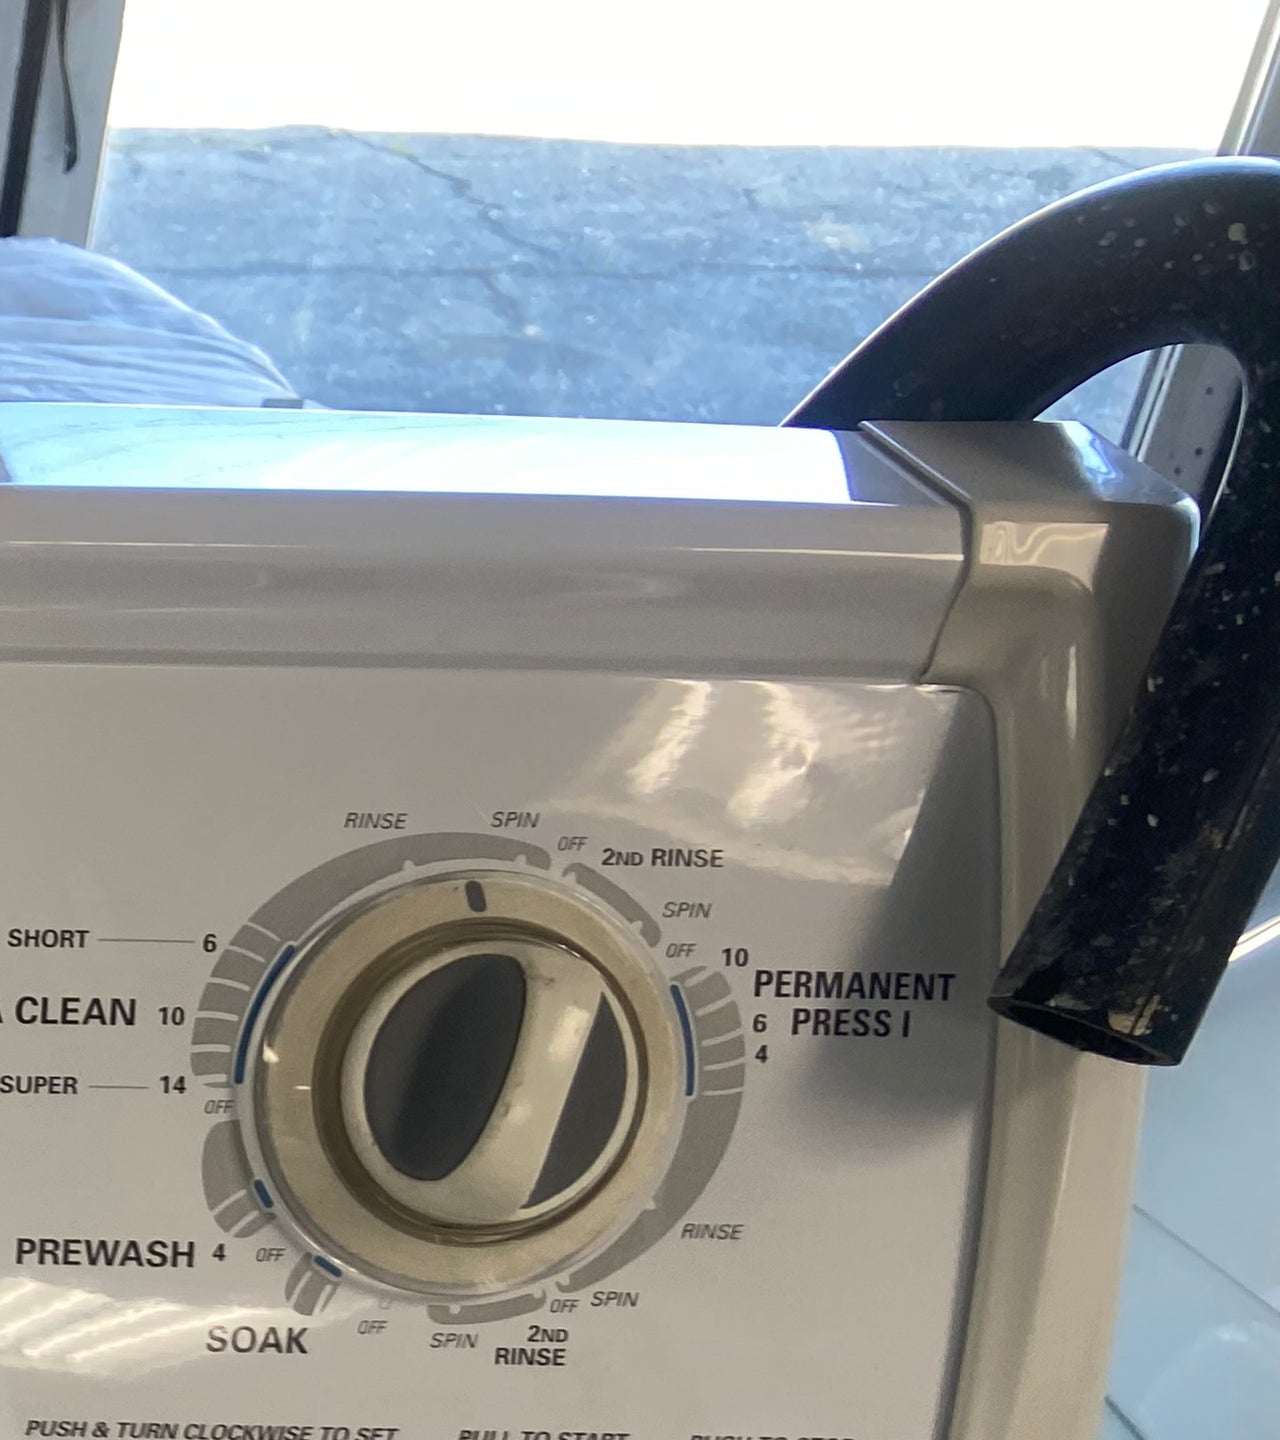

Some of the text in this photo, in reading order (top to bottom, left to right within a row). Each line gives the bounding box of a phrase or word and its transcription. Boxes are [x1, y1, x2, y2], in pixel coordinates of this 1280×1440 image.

[344, 812, 408, 830] RINSE
[491, 811, 540, 829] SPIN
[557, 836, 588, 853] OFF
[601, 847, 725, 869] 2ND RINSE
[662, 901, 713, 919] SPIN
[7, 929, 90, 948] SHORT
[203, 934, 218, 953] 6
[665, 942, 697, 959] OFF
[721, 947, 749, 968] 10
[753, 970, 956, 1001] PERMANENT
[15, 996, 137, 1026] CLEAN
[158, 1007, 185, 1026] 10
[753, 1013, 767, 1034] 6
[791, 1008, 892, 1037] PRESS
[754, 1045, 768, 1064] 4
[0, 1075, 78, 1095] SUPER
[160, 1076, 186, 1094] 14
[204, 1099, 235, 1115] OFF
[680, 1223, 744, 1241] RINSE
[15, 1238, 226, 1268] PREWASH 4
[255, 1247, 285, 1262] OFF
[550, 1298, 579, 1314] OFF
[590, 1291, 640, 1308] SPIN
[357, 1320, 387, 1336] OFF
[527, 1324, 569, 1344] 2ND
[206, 1325, 308, 1355] SOAK
[429, 1332, 478, 1349] SPIN
[494, 1347, 567, 1366] RINSE
[26, 1420, 88, 1437] PUSH
[91, 1422, 110, 1438] &
[116, 1422, 178, 1440] TURN
